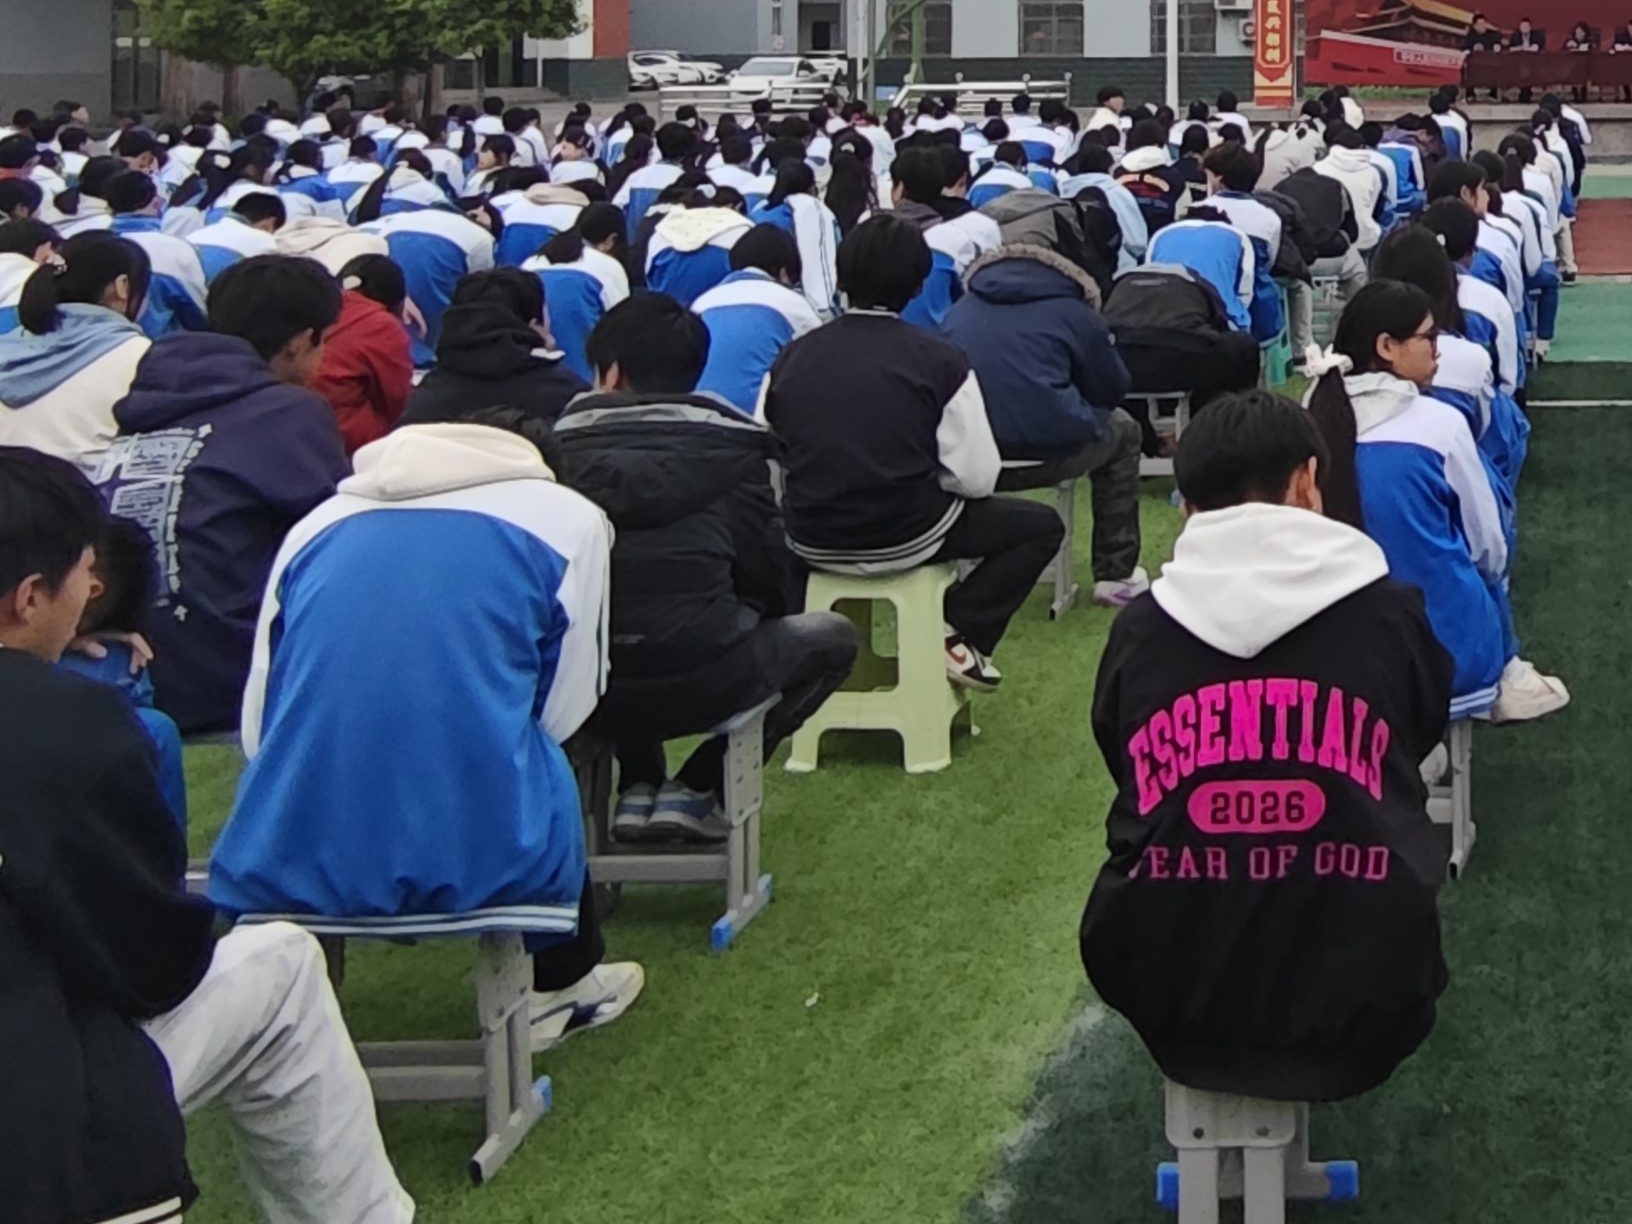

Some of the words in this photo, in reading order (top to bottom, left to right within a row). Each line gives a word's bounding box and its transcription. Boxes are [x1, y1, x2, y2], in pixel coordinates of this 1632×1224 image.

[1128, 678, 1389, 815] ESSENTIALS
[1210, 790, 1305, 825] 2026
[1249, 845, 1298, 880] OF
[1314, 841, 1389, 880] GOD
